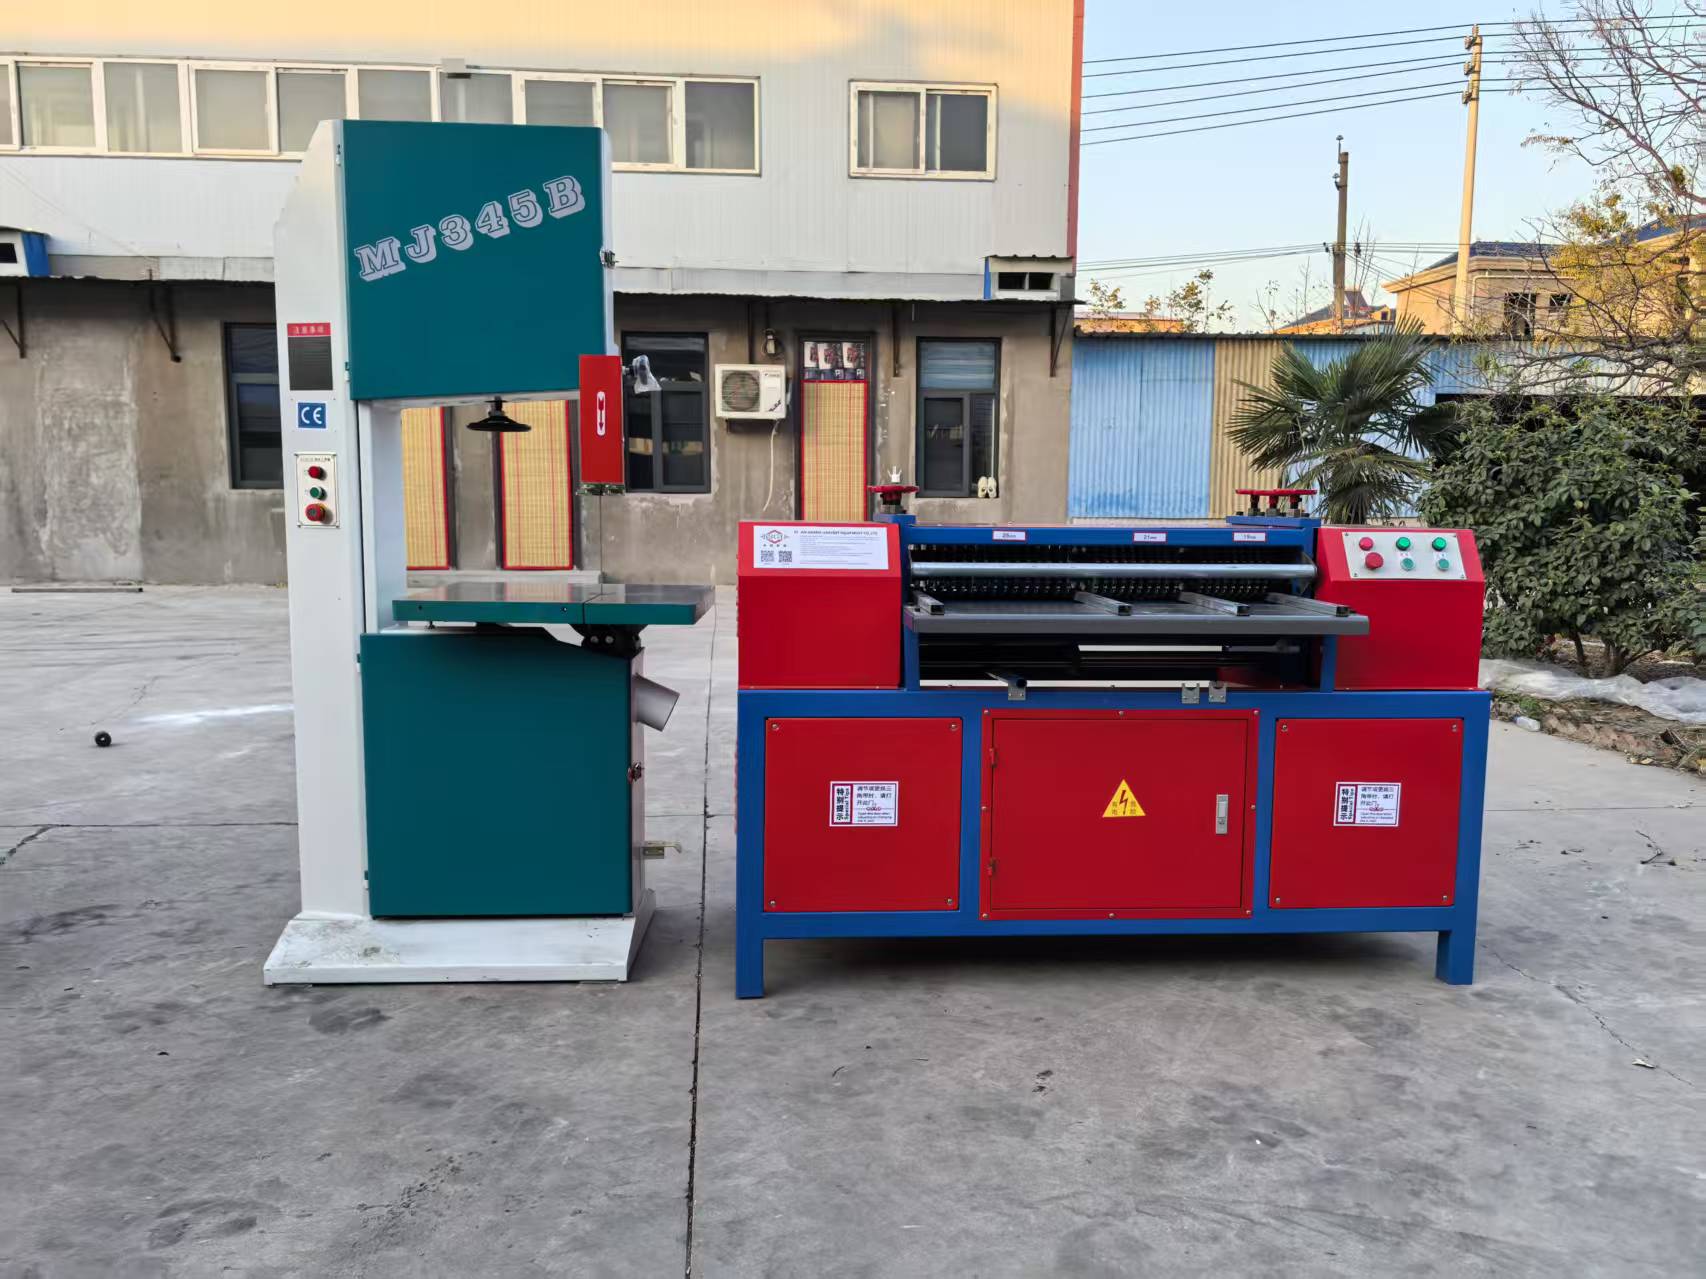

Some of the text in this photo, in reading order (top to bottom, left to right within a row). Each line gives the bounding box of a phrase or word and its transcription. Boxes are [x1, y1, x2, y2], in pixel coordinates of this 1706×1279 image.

[354, 175, 586, 282] MJ345B
[301, 406, 322, 424] CE
[836, 788, 844, 820] 特别提示
[1340, 788, 1348, 820] 特别提示
